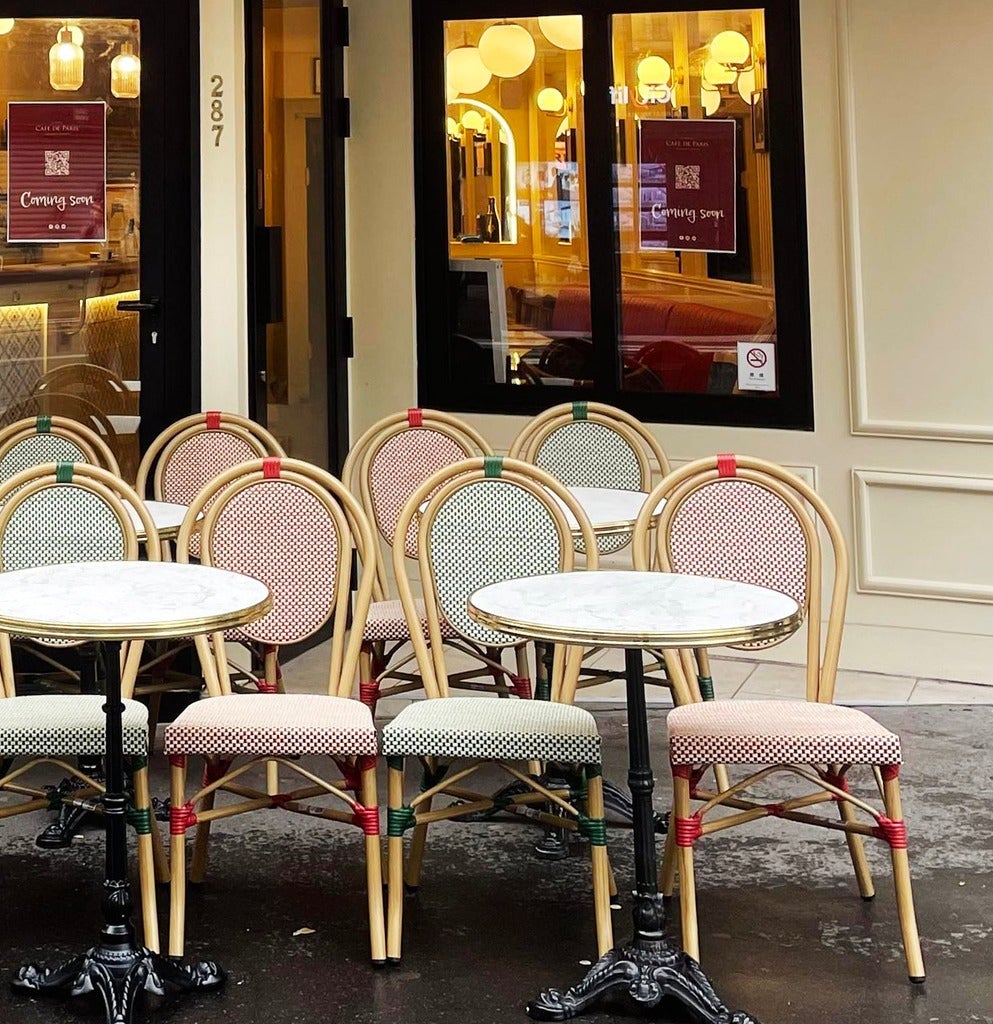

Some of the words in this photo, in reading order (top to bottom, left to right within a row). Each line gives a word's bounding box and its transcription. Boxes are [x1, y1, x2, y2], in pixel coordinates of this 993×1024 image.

[210, 74, 224, 147] 287
[20, 191, 66, 211] Coming
[69, 195, 94, 206] soon
[651, 203, 696, 223] Coming
[700, 210, 725, 221] soon
